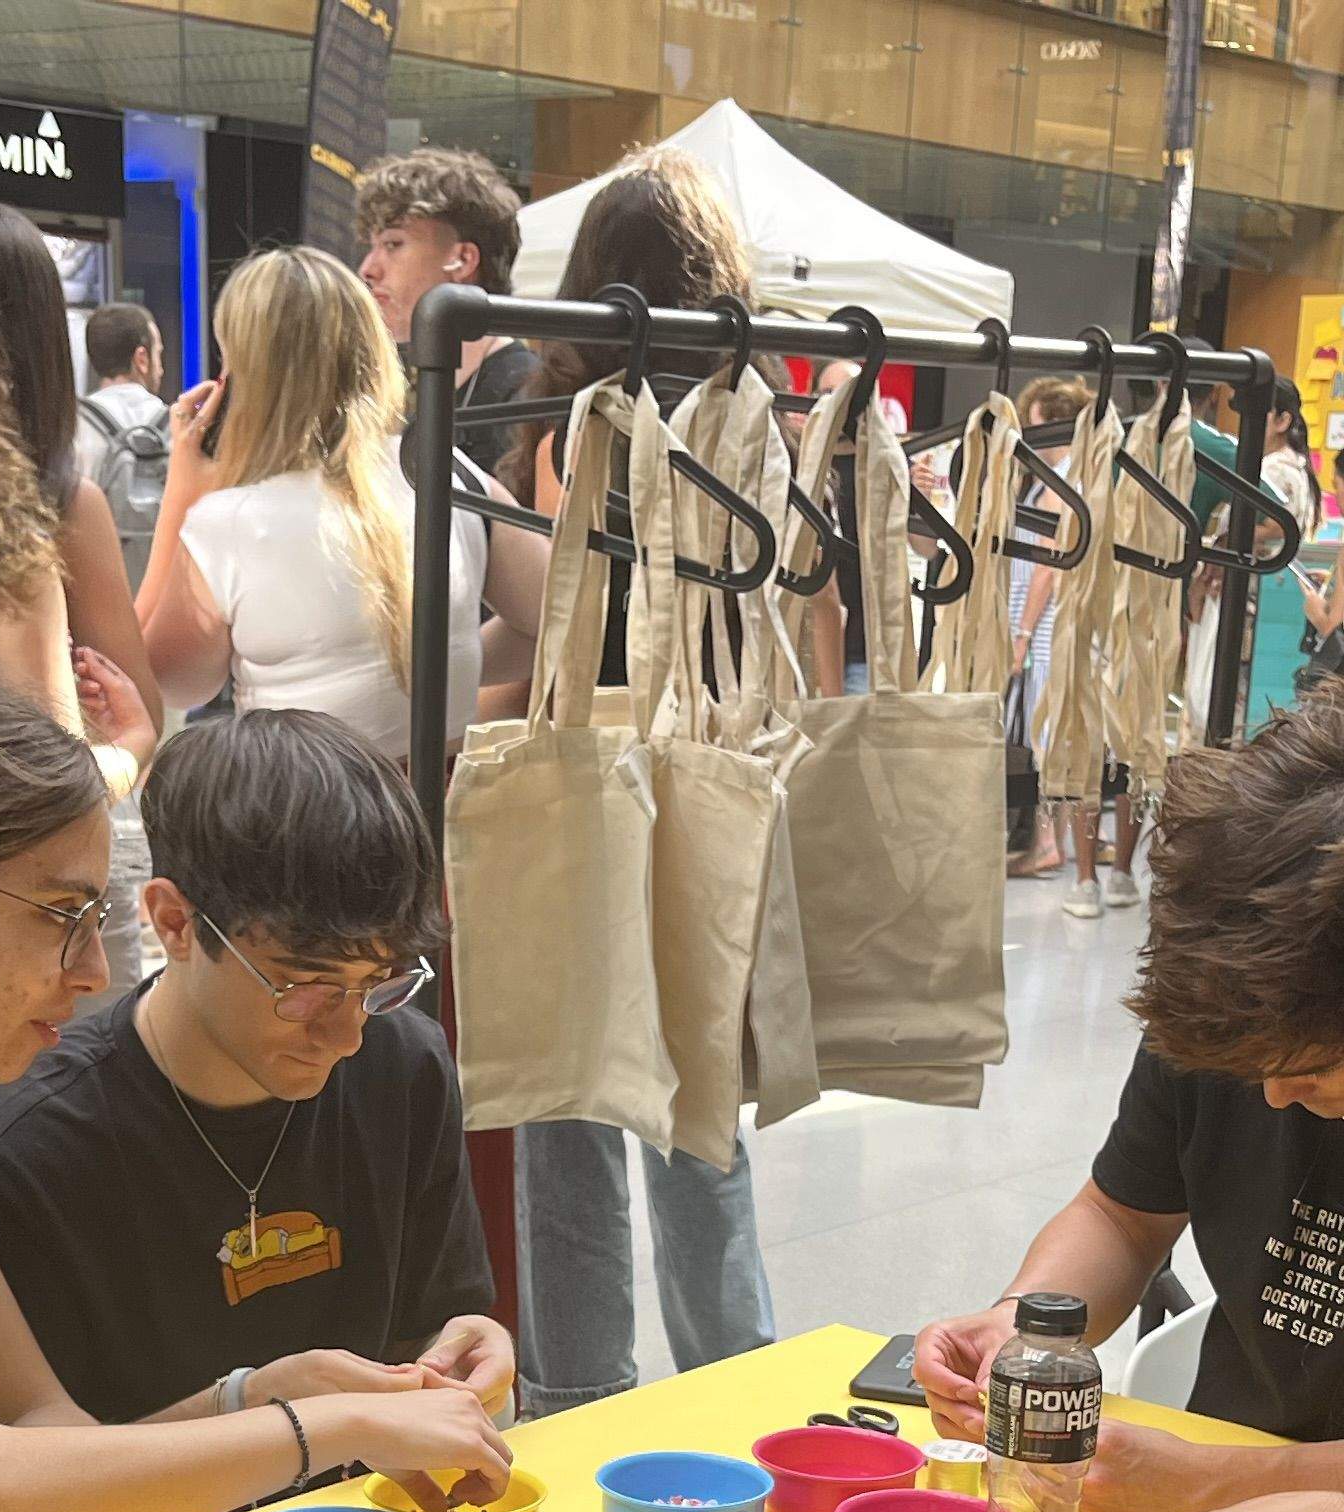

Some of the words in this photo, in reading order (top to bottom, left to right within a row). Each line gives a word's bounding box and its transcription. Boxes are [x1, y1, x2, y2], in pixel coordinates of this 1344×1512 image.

[1290, 1198, 1313, 1221] THE
[1264, 1236, 1296, 1262] NEW
[1299, 1250, 1336, 1277] YORK
[1260, 1285, 1322, 1320] DOESN'T
[1262, 1309, 1289, 1331] ME
[1290, 1318, 1335, 1347] SLEEP
[1025, 1384, 1101, 1412] POWER
[1066, 1407, 1100, 1432] ADE
